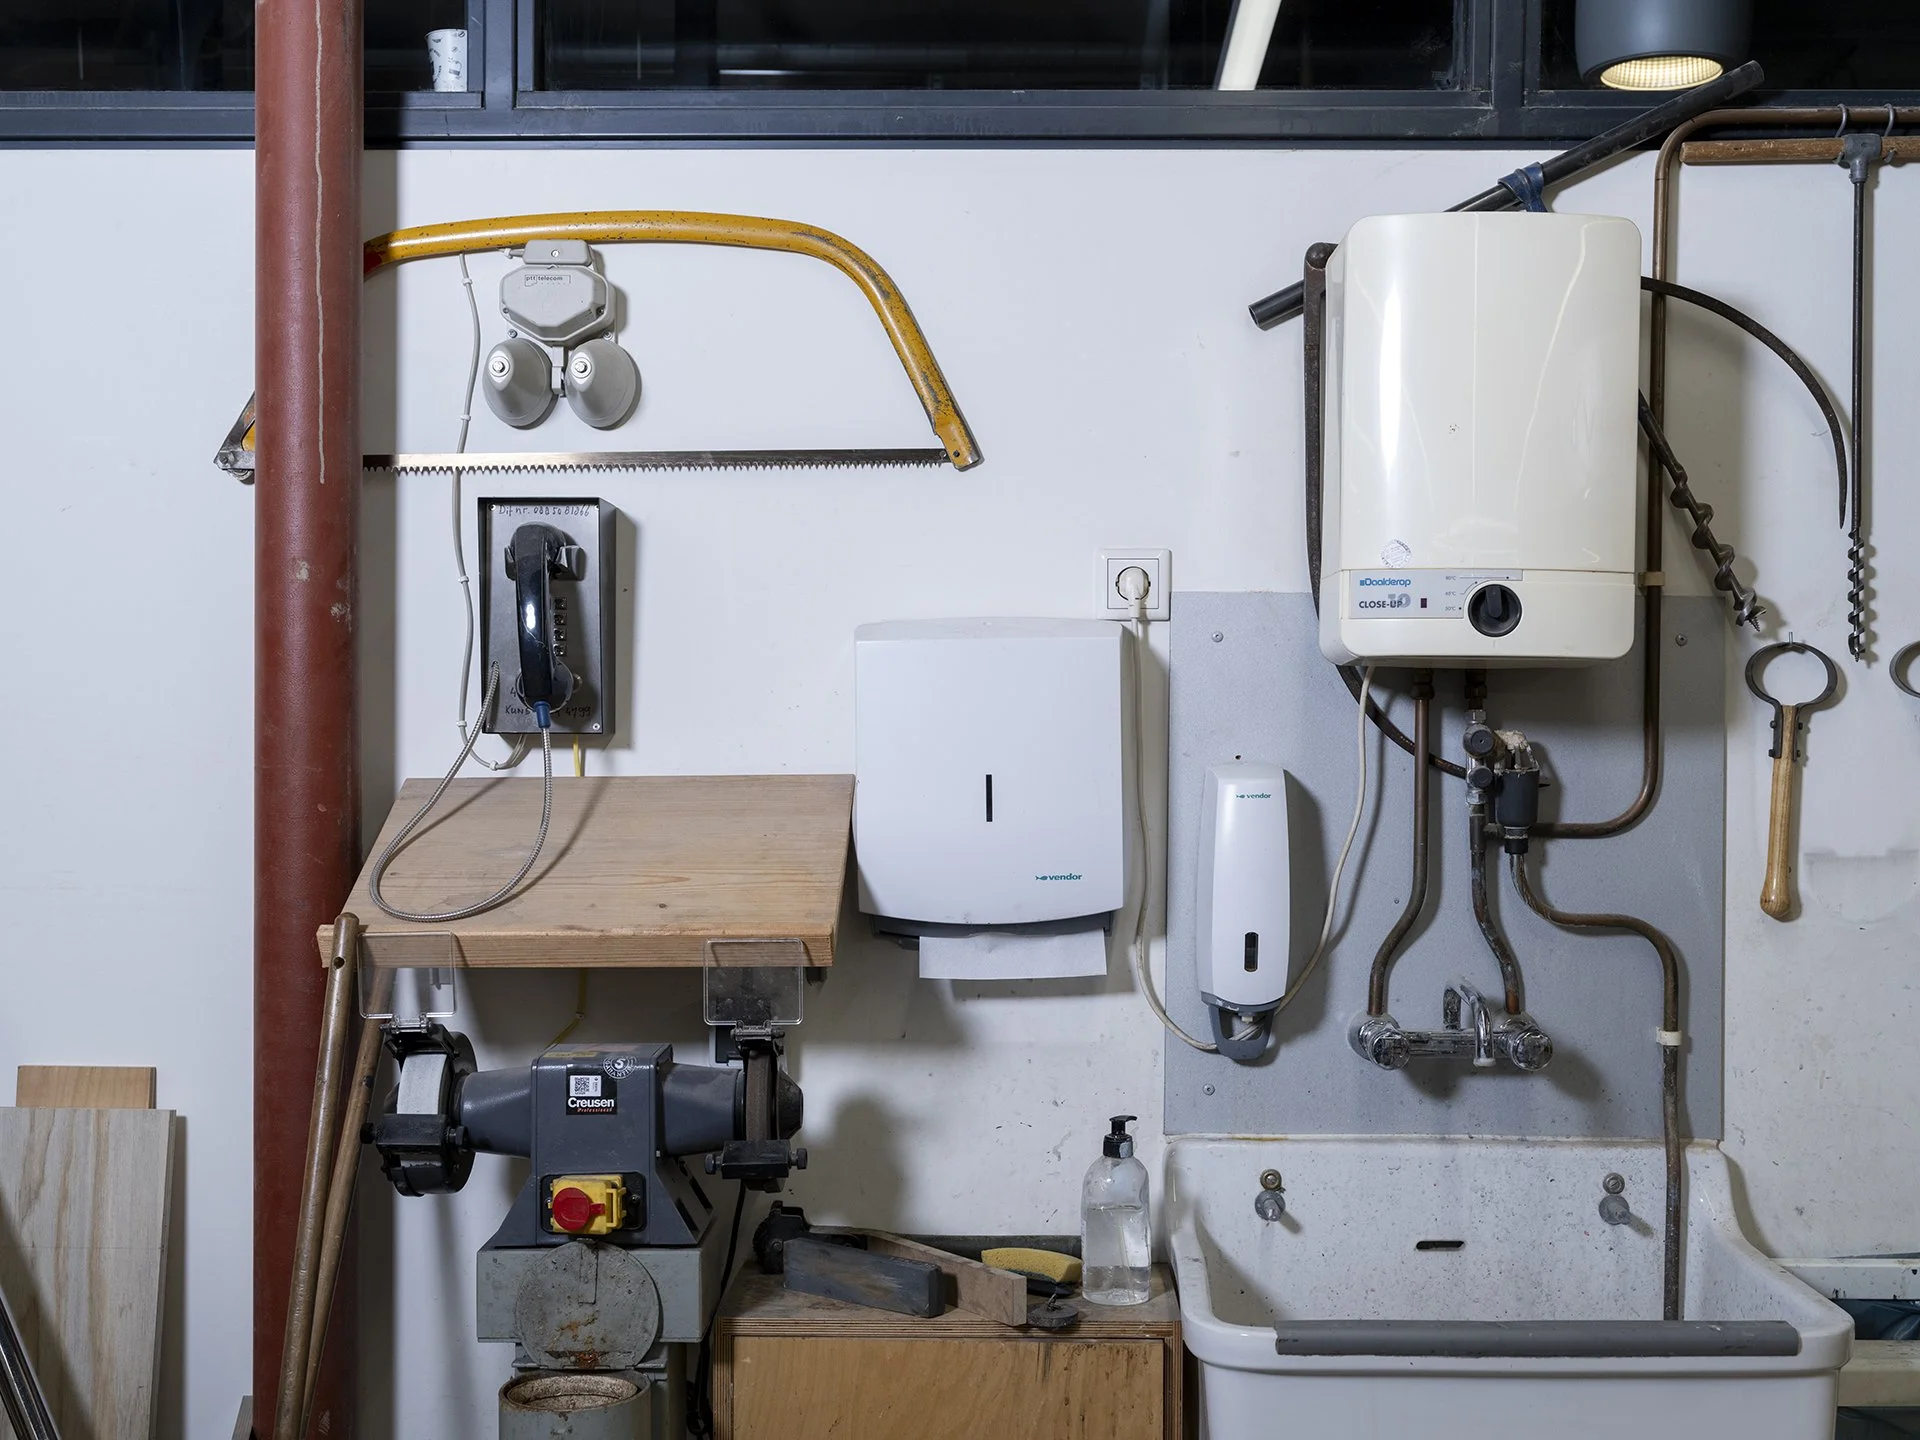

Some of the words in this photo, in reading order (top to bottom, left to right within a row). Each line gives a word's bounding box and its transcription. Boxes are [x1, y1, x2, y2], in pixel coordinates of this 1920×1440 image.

[1364, 578, 1412, 588] Daalderop
[1358, 600, 1404, 609] CLOSE-UP
[567, 1097, 615, 1108] Creusen
